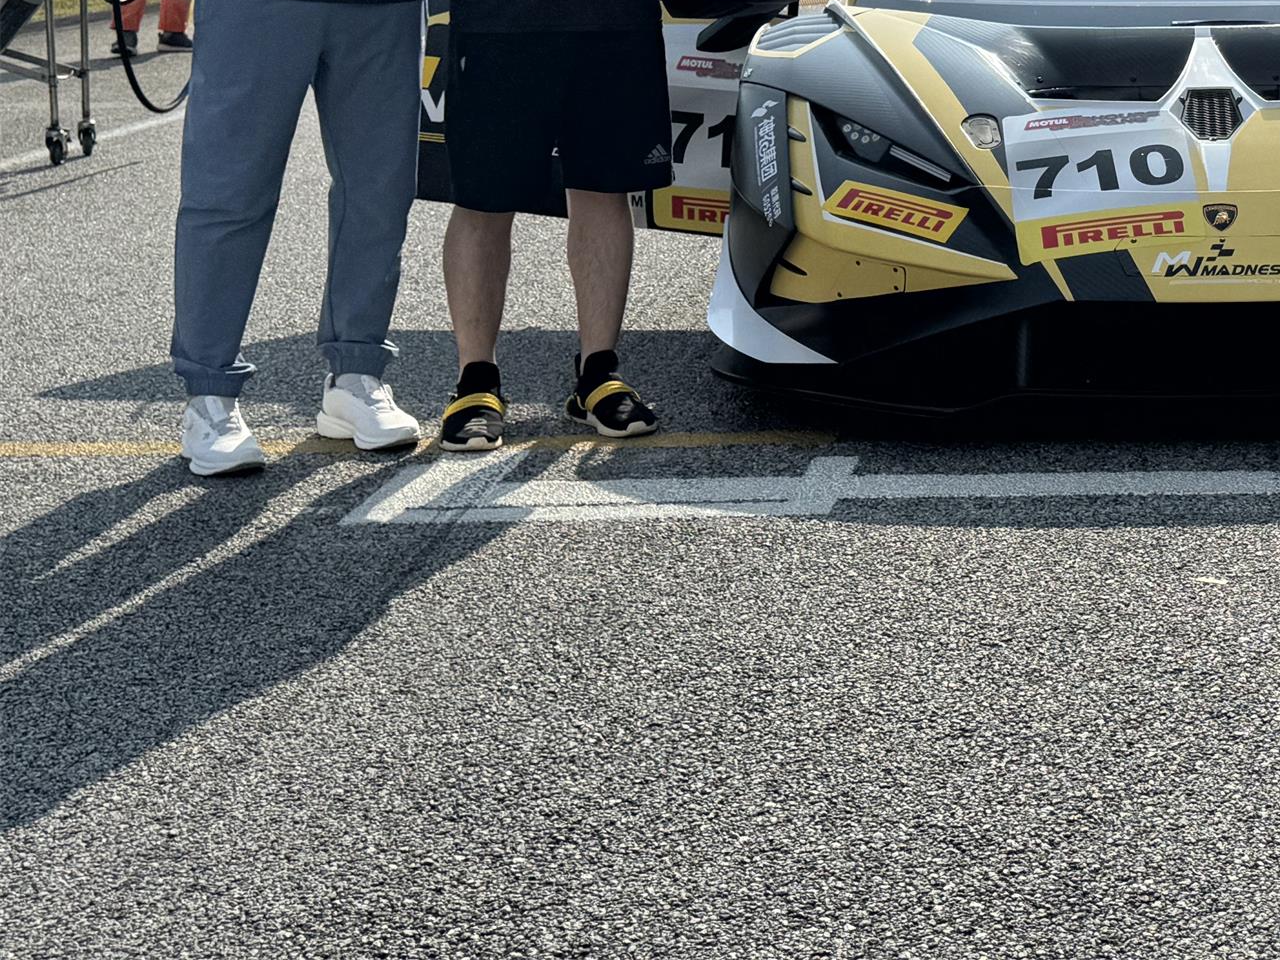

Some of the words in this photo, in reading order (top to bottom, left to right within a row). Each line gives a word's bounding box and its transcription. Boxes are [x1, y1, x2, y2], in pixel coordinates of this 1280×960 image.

[680, 58, 714, 69] MOTUL
[1028, 118, 1069, 128] MOTUL
[1015, 144, 1185, 200] 710
[836, 188, 953, 233] PIRELLI
[1041, 210, 1185, 249] PIRELLI
